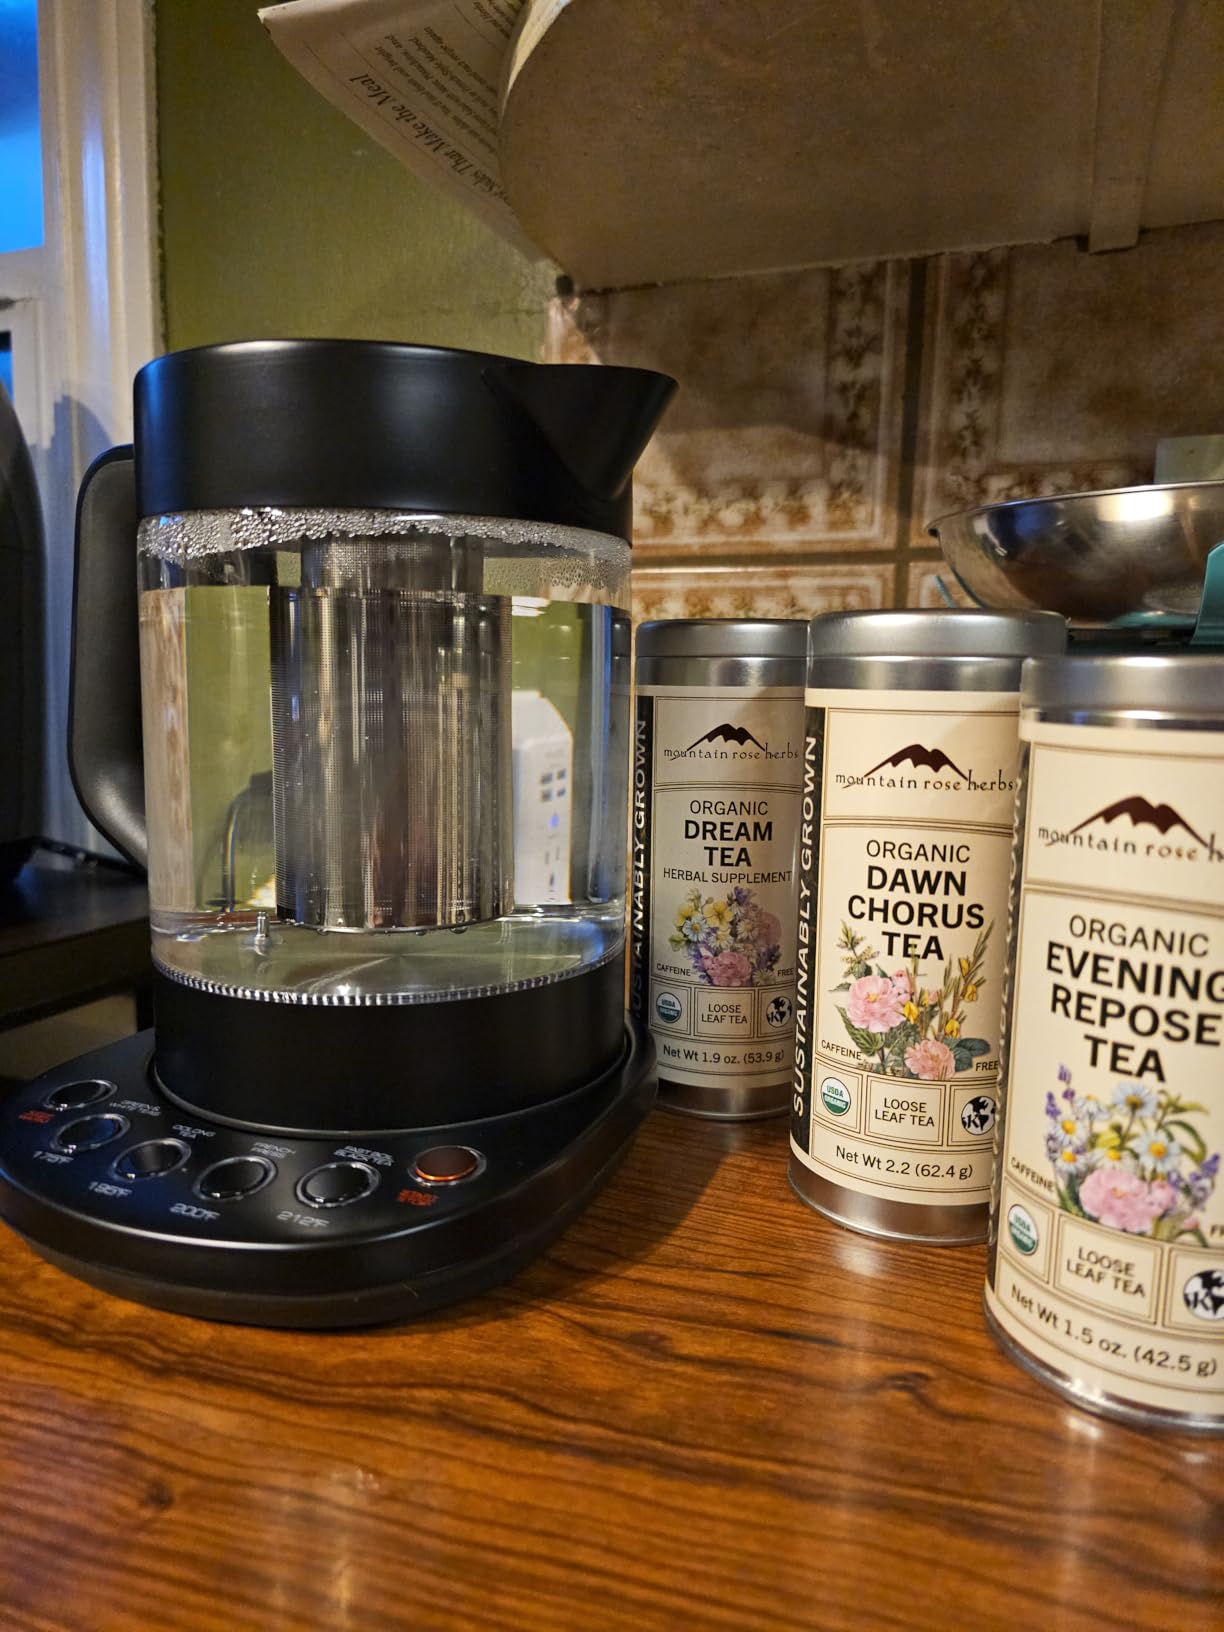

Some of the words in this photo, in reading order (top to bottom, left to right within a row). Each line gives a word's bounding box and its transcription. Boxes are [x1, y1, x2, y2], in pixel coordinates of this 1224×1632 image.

[350, 73, 392, 107] Meal
[391, 104, 417, 122] the
[415, 121, 447, 153] Make
[444, 151, 474, 174] That
[664, 749, 728, 761] mountain
[733, 751, 760, 759] rose
[765, 742, 799, 760] herbs
[635, 720, 646, 829] GROWN
[836, 773, 917, 789] mountain
[924, 780, 961, 791] rose
[967, 769, 1014, 791] herbs
[690, 800, 768, 816] ORGANIC
[801, 736, 817, 871] GROWN
[685, 820, 773, 842] DREAM
[1038, 826, 1137, 855] mountain
[1145, 843, 1199, 861] rose
[704, 847, 752, 867] TEA
[866, 839, 970, 863] ORGANIC
[663, 868, 708, 883] HERBAL
[711, 870, 793, 884] SUPPLEMENT
[867, 865, 967, 896] DAWN
[848, 895, 984, 929] CHORUS
[631, 838, 645, 1018] USTAINABLY
[1069, 915, 1209, 958] ORGANIC
[881, 931, 944, 961] TEA
[656, 963, 691, 977] CAFFEINE
[777, 967, 794, 977] FREE
[708, 1004, 742, 1014] LOOSE
[794, 880, 811, 1117] SUSTAINABLY
[701, 1015, 725, 1023] LEAF
[728, 1015, 748, 1024] TEA
[1050, 983, 1223, 1046] REPOSE
[663, 1045, 681, 1059] Net
[683, 1049, 699, 1061] Wt
[702, 1052, 721, 1063] 1.9
[724, 1055, 741, 1064] oz.
[743, 1053, 773, 1064] (53.9
[774, 1050, 785, 1063] g)
[821, 1040, 862, 1061] CAFFEINE
[976, 1060, 999, 1072] FREE
[1083, 1035, 1166, 1082] TEA
[827, 1085, 844, 1098] USDA
[883, 1097, 927, 1112] LOOSE
[875, 1109, 905, 1123] LEAF
[910, 1114, 935, 1127] TEA
[33, 1151, 74, 1164] 175F
[836, 1145, 858, 1164] Net
[862, 1154, 882, 1170] Wt
[886, 1159, 910, 1175] 2.2
[915, 1163, 956, 1178] (62.4
[959, 1164, 973, 1180] g)
[1011, 1157, 1055, 1192] CAFFEINE
[169, 1203, 221, 1221] 200F
[276, 1211, 330, 1228] 212F
[1078, 1247, 1136, 1277] LOOSE
[1067, 1260, 1107, 1285] LEAF
[1113, 1274, 1145, 1298] TEA
[1011, 1284, 1034, 1311] Net
[1037, 1304, 1059, 1329] Wt
[1065, 1319, 1094, 1345] 1.5
[1098, 1339, 1127, 1359] oz.
[1133, 1345, 1192, 1373] (42.5
[1196, 1357, 1218, 1377] g)
